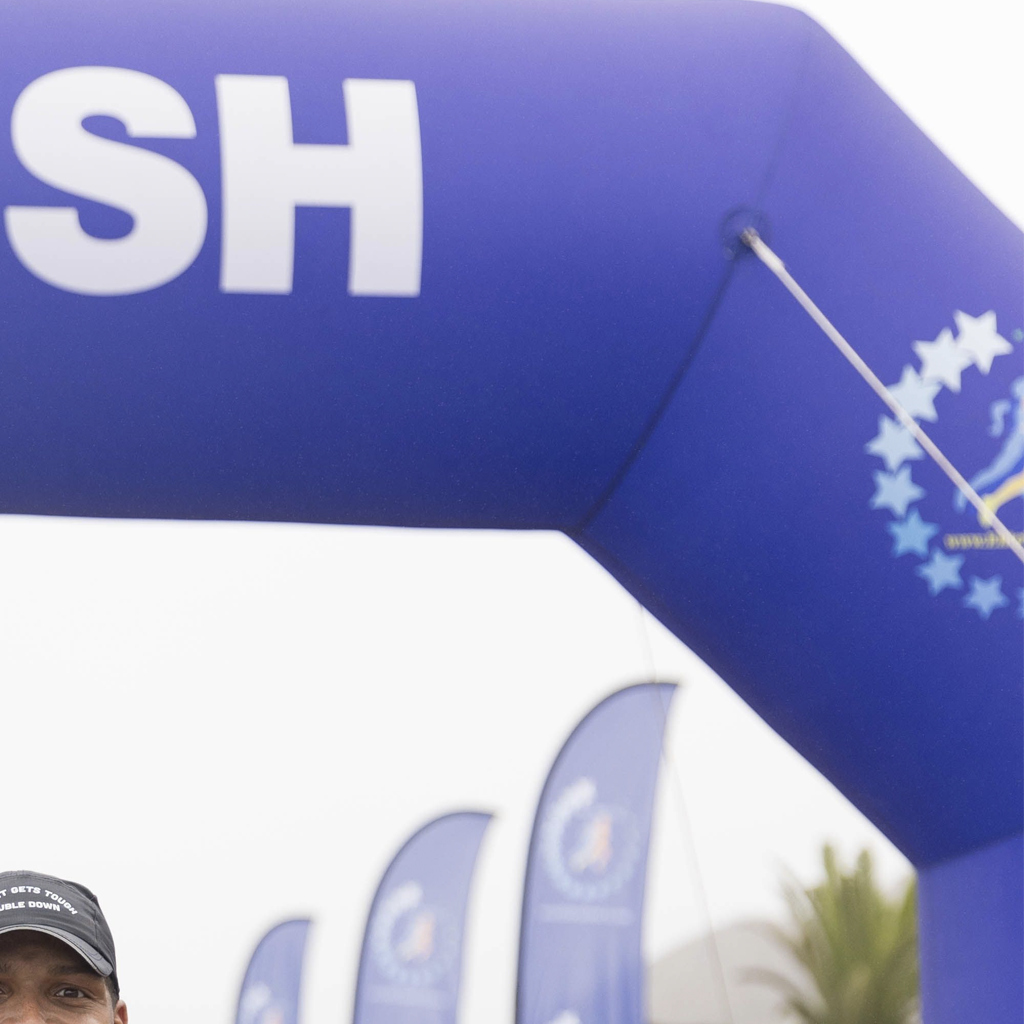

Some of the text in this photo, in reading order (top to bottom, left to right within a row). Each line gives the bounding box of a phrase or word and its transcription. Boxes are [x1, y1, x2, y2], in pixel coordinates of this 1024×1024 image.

[10, 886, 41, 894] GETS
[44, 890, 78, 915] TOUGH
[28, 901, 61, 911] DOWN
